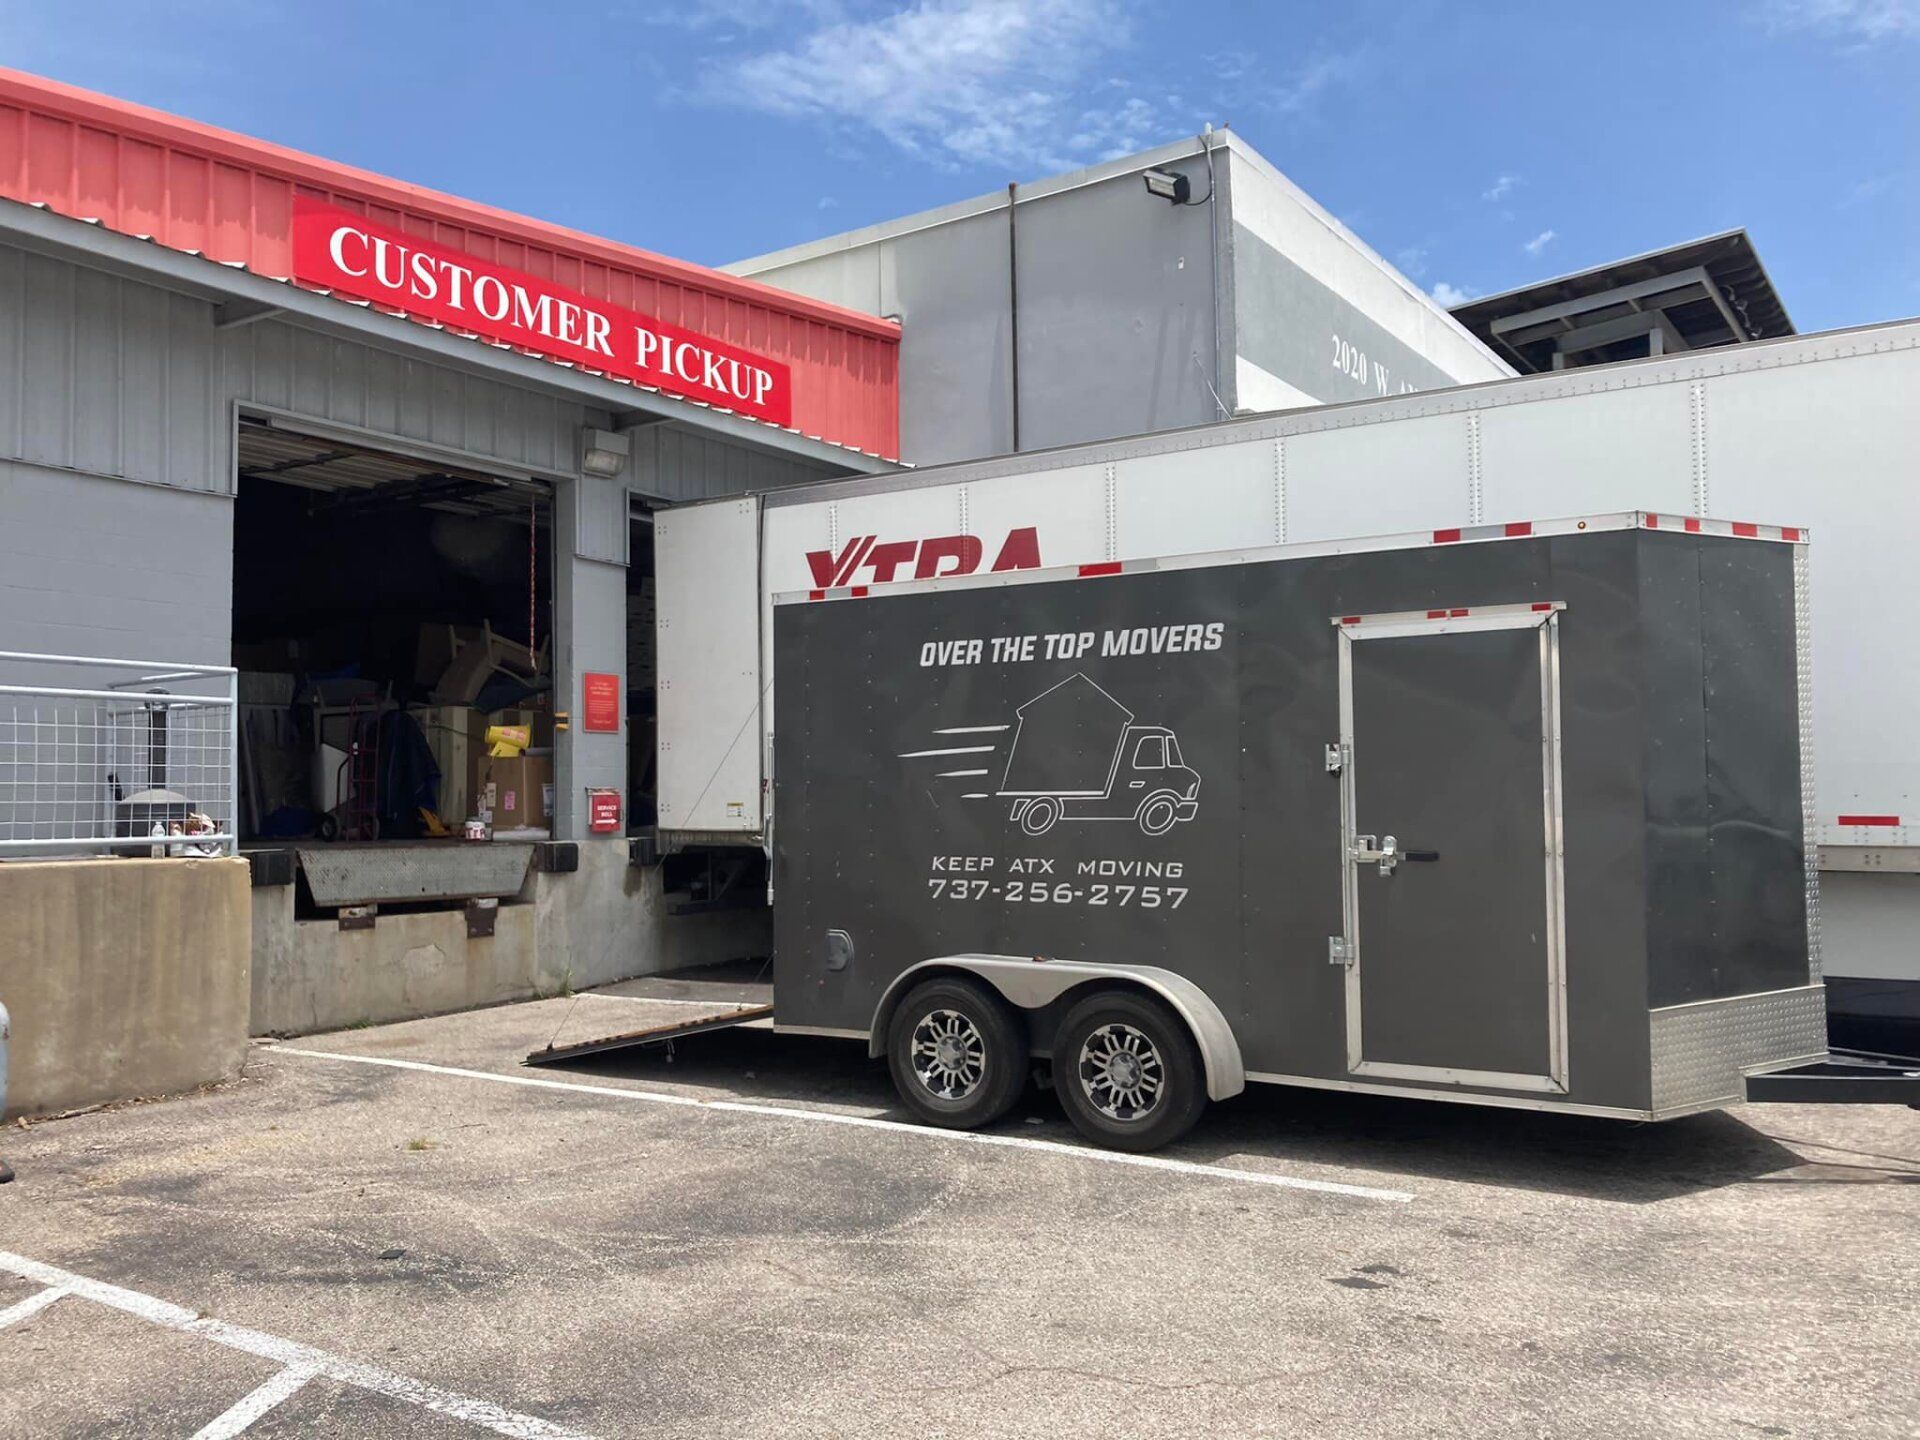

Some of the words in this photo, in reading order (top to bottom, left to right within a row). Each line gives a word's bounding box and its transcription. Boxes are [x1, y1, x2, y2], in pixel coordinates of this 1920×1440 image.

[329, 226, 615, 358] CUSTOMER
[633, 325, 773, 406] PICKUP
[1332, 334, 1367, 385] 2020
[919, 639, 984, 667] OVER
[991, 635, 1038, 663] THE
[1044, 632, 1096, 660] TOP
[1101, 622, 1225, 657] MOVERS
[931, 856, 995, 871] KEEP
[1009, 858, 1055, 874] ATX
[1077, 860, 1184, 878] MOVING
[928, 879, 1190, 909] 737-256-2757
